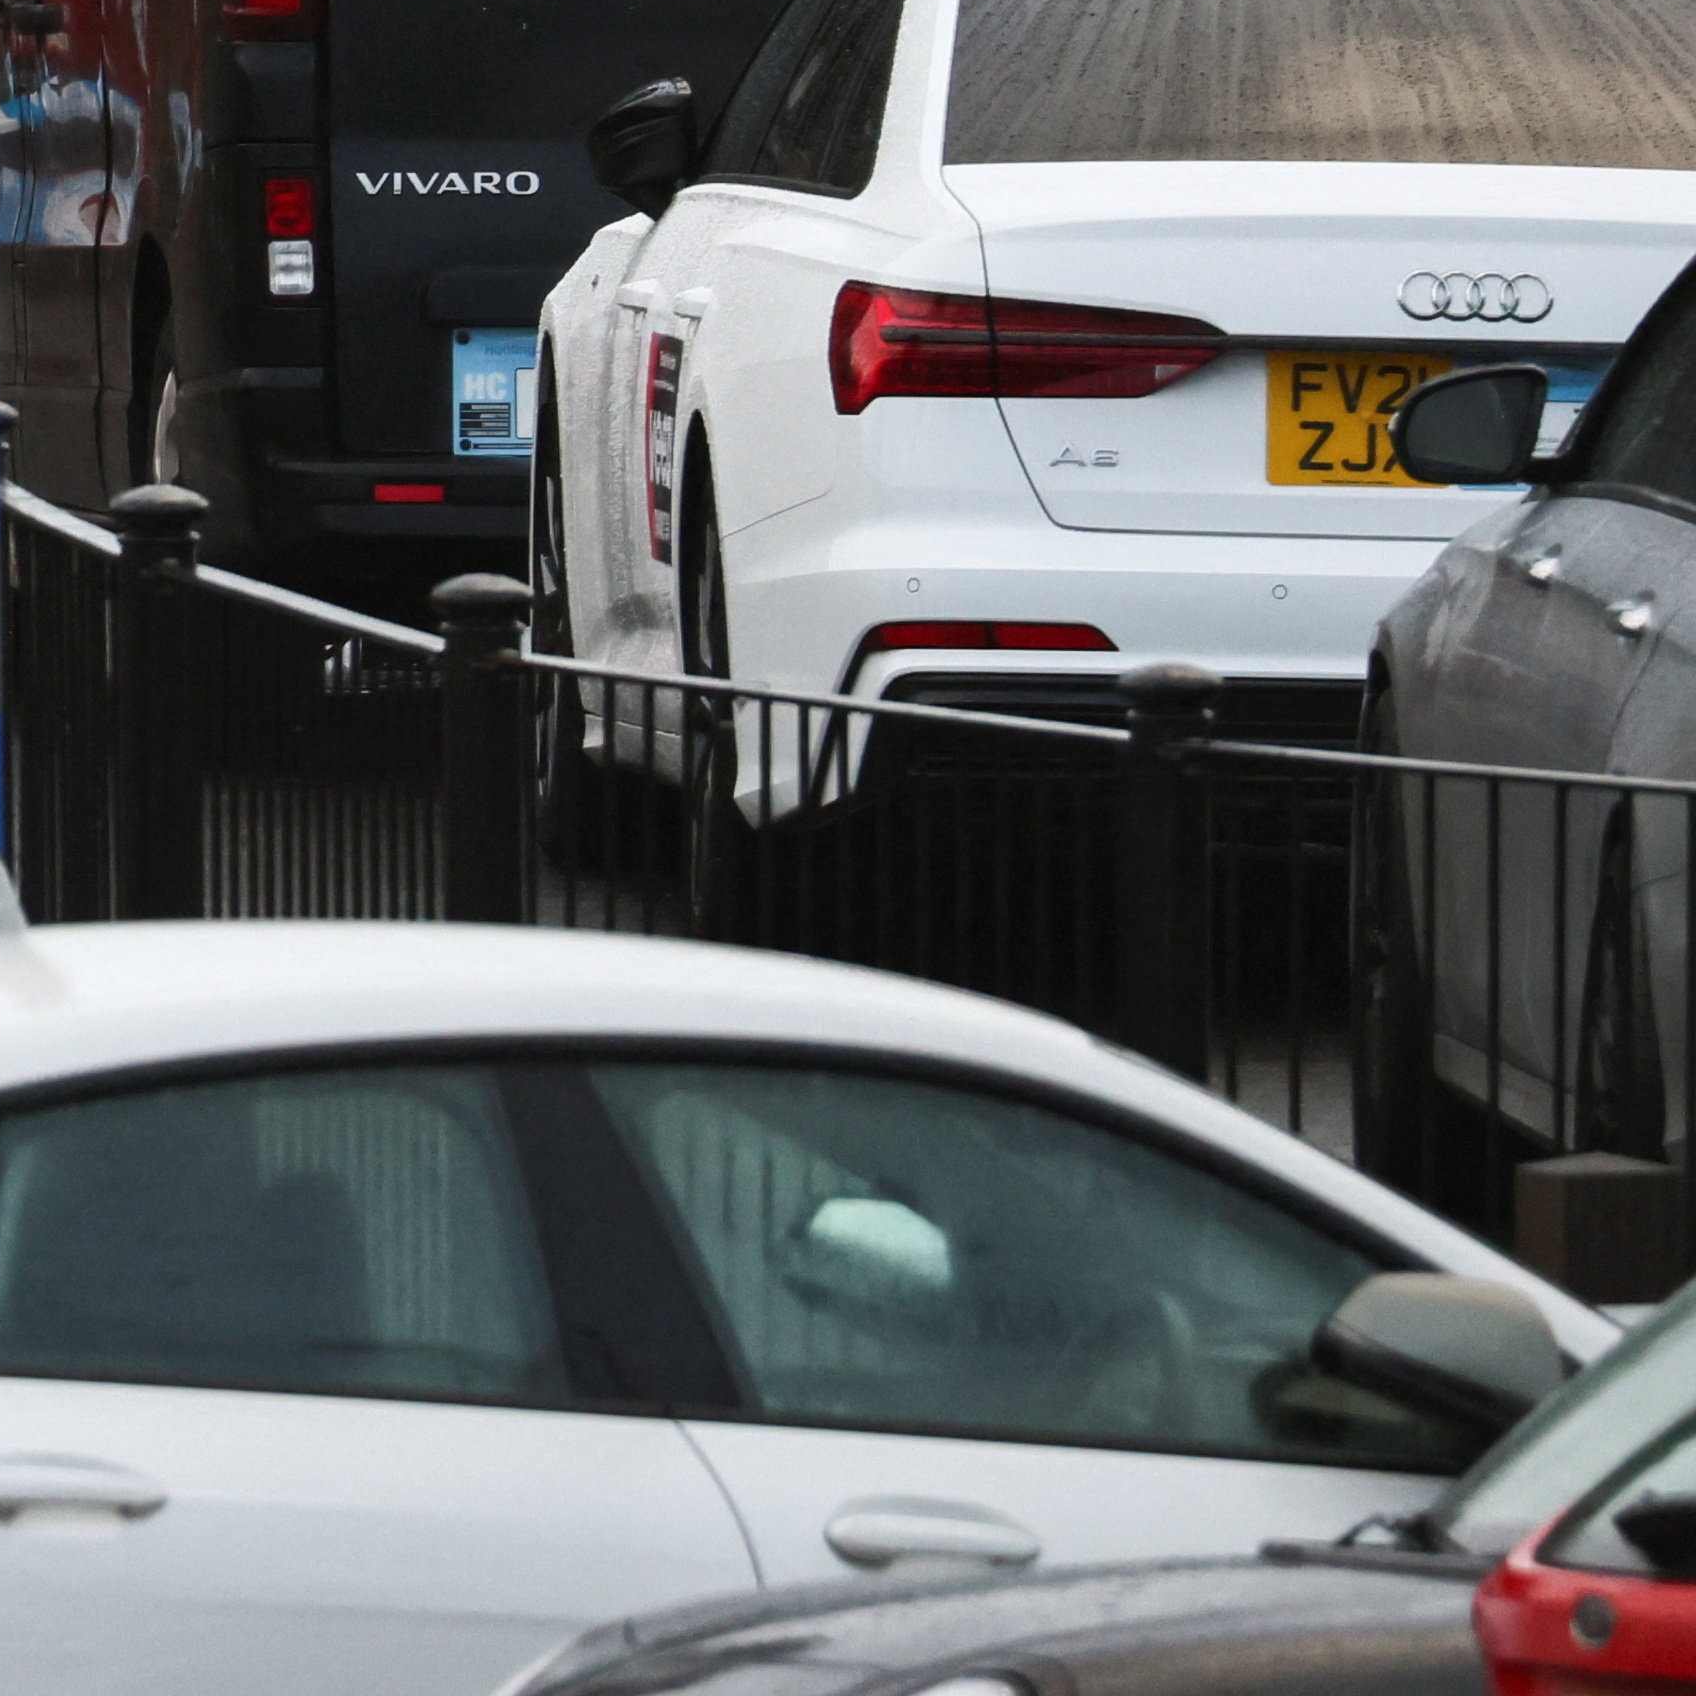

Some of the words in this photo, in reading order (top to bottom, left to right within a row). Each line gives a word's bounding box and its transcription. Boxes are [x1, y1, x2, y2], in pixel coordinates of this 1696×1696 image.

[354, 170, 540, 196] VIVARO
[463, 372, 507, 401] HC
[1290, 362, 1428, 415] FV2
[1048, 445, 1120, 468] A6
